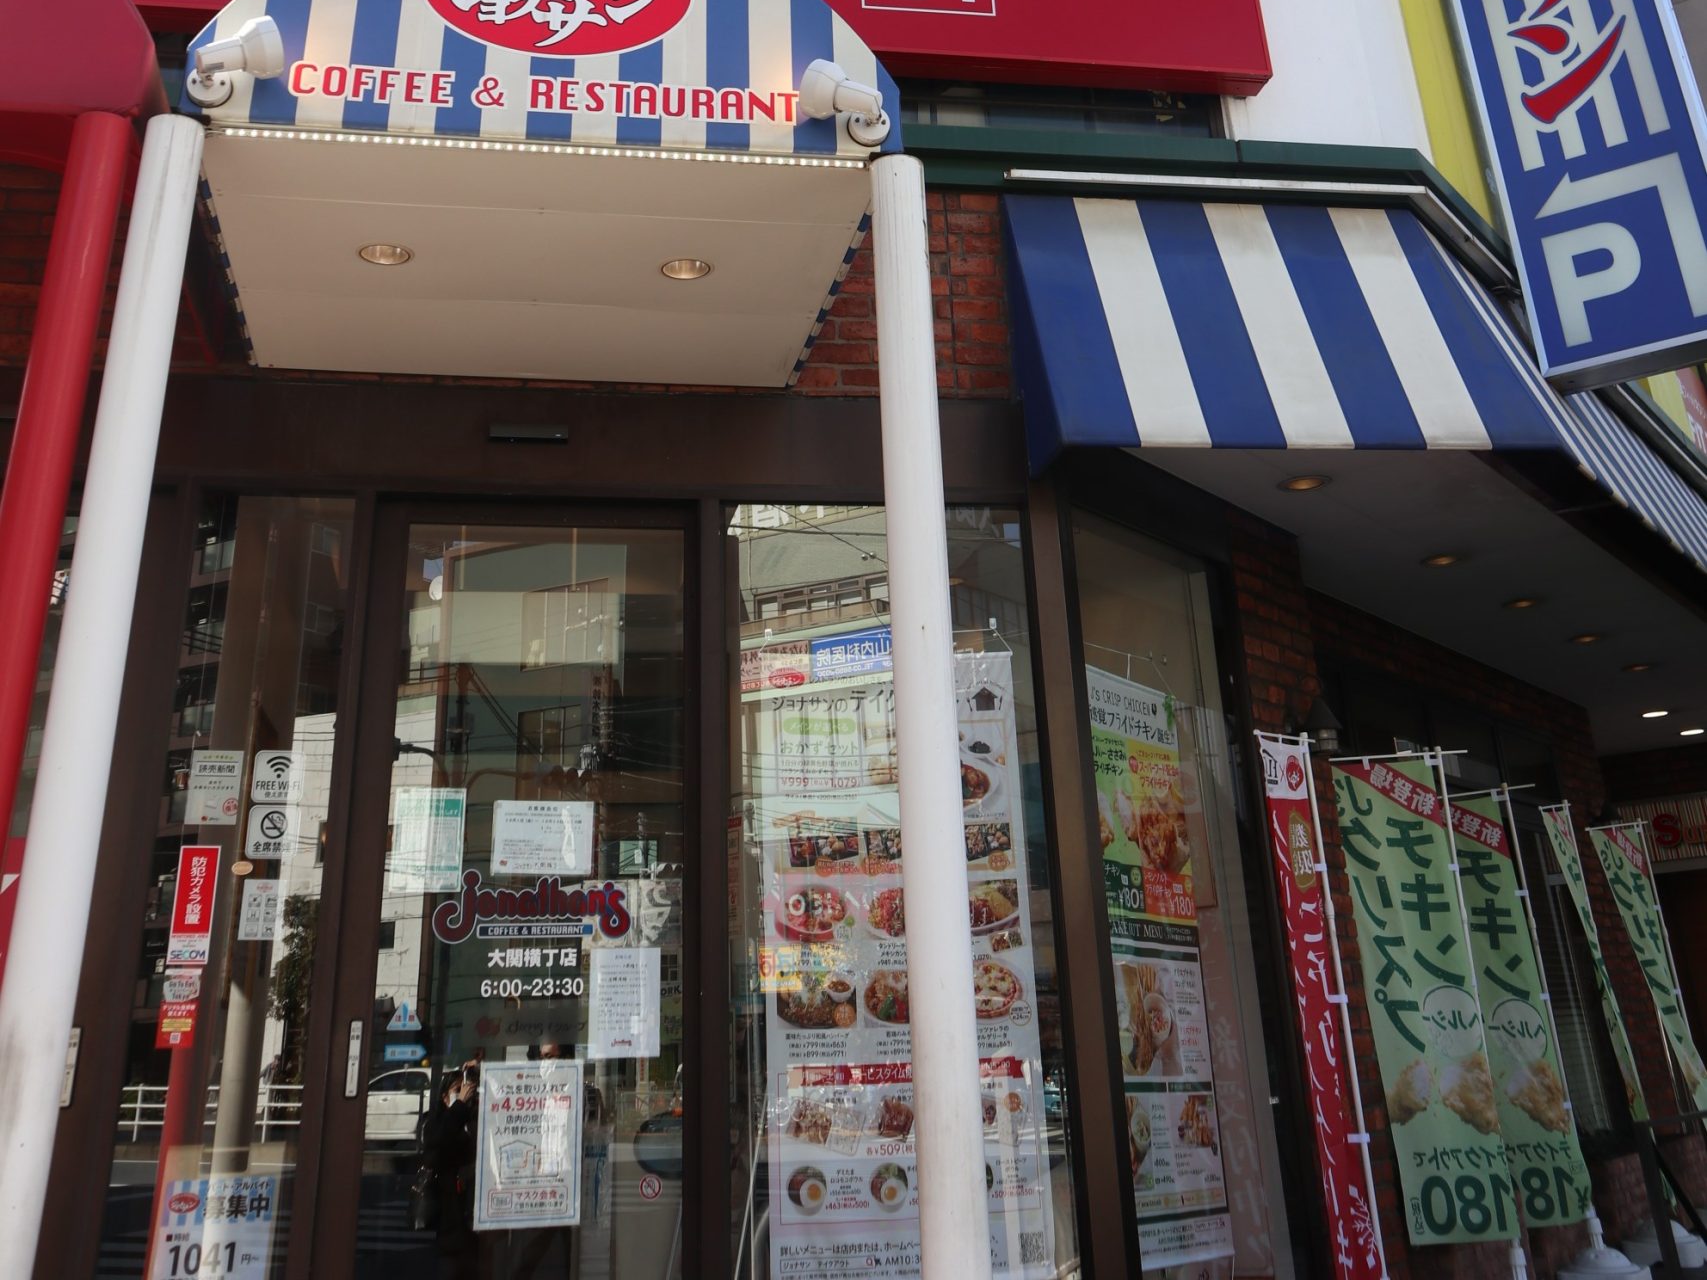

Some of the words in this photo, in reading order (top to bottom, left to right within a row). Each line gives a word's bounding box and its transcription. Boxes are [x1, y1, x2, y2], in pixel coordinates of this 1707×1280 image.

[291, 63, 454, 106] COFFEE
[473, 77, 504, 108] &
[529, 78, 800, 125] RESTAURANT
[1541, 222, 1642, 345] P
[1103, 688, 1121, 708] CRISP
[1124, 696, 1151, 717] CHICKEN
[255, 780, 277, 791] FREE
[184, 855, 207, 925] 防犯カメラ設置
[488, 925, 519, 936] COFFEE
[521, 926, 529, 935] &
[531, 925, 584, 936] RESTAURANT
[1109, 920, 1141, 936] AKEOUT
[1143, 924, 1163, 938] MENU
[170, 949, 207, 960] SECOM
[487, 948, 578, 968] 大関横丁店
[203, 1194, 271, 1220] 募集中
[169, 1241, 237, 1277] 1041
